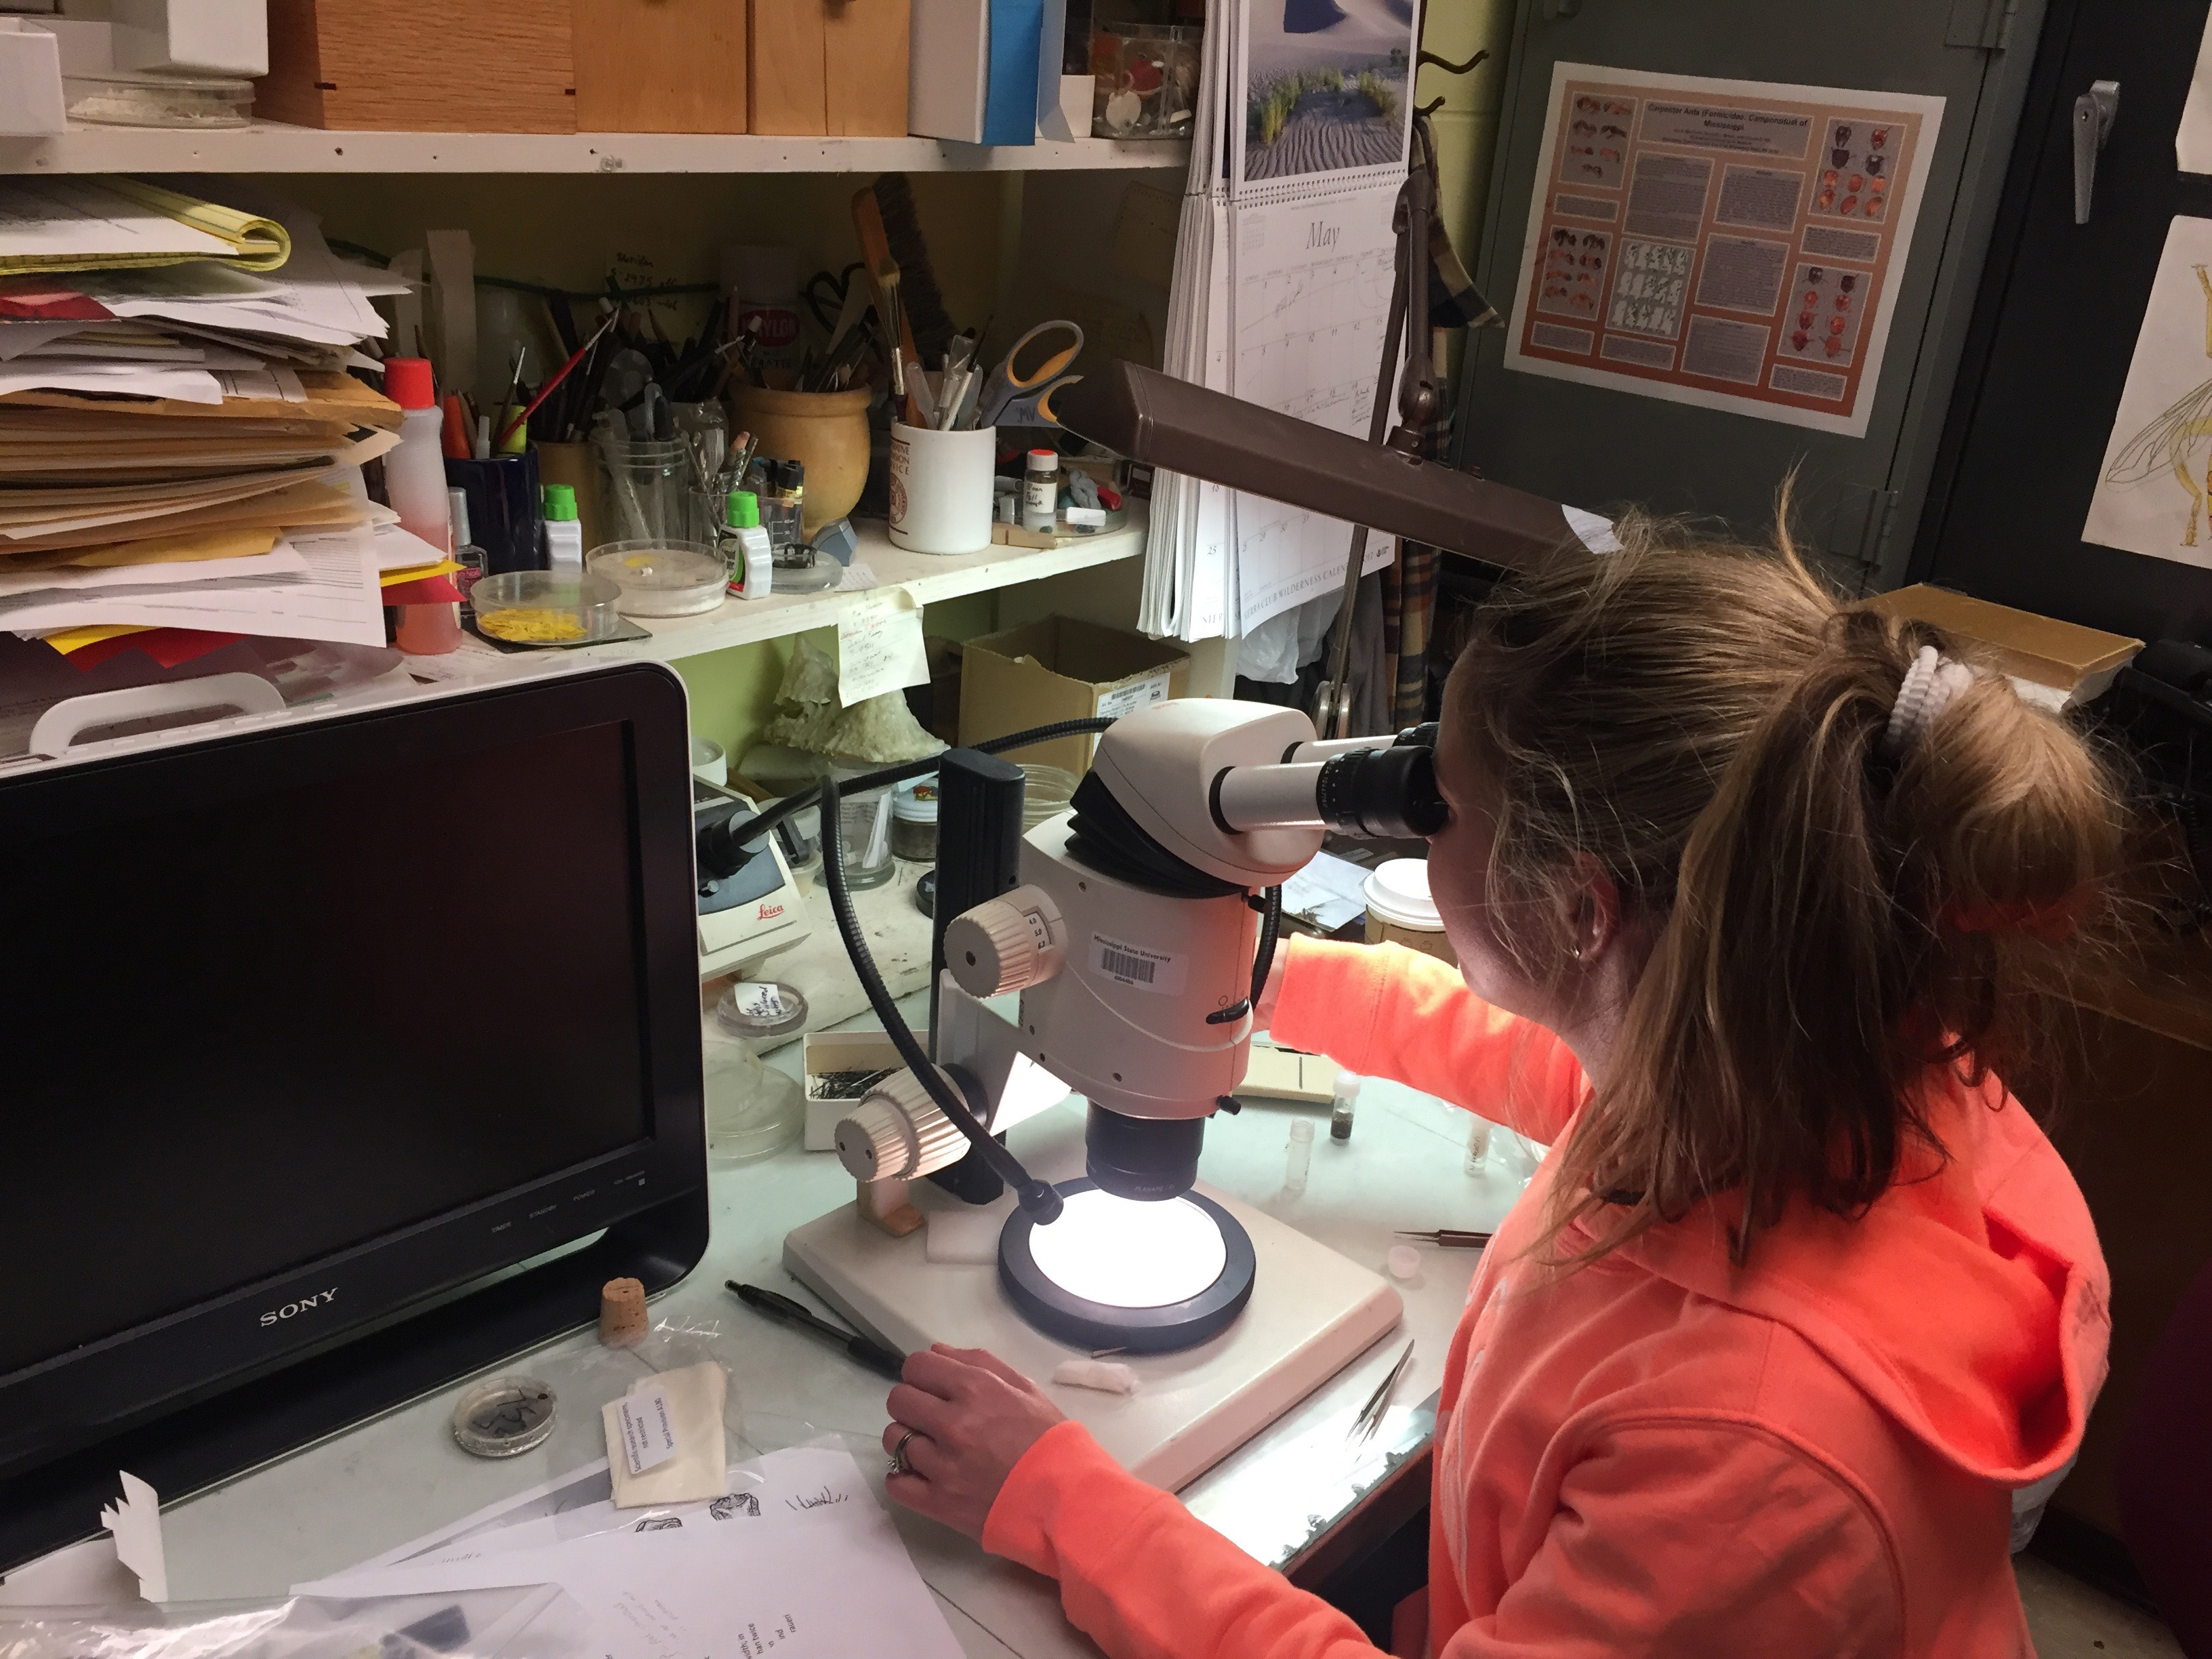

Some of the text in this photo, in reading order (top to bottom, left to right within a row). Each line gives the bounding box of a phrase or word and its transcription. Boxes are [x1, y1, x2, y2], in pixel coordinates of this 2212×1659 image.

[1305, 220, 1340, 253] May
[741, 317, 798, 337] KYLON
[1278, 571, 1322, 598] WILDERNESS
[756, 903, 785, 920] Leica
[1034, 928, 1042, 937] 5.0
[1093, 934, 1171, 964] Mississippi State University
[260, 1288, 338, 1327] SONY
[747, 1622, 760, 1641] twice
